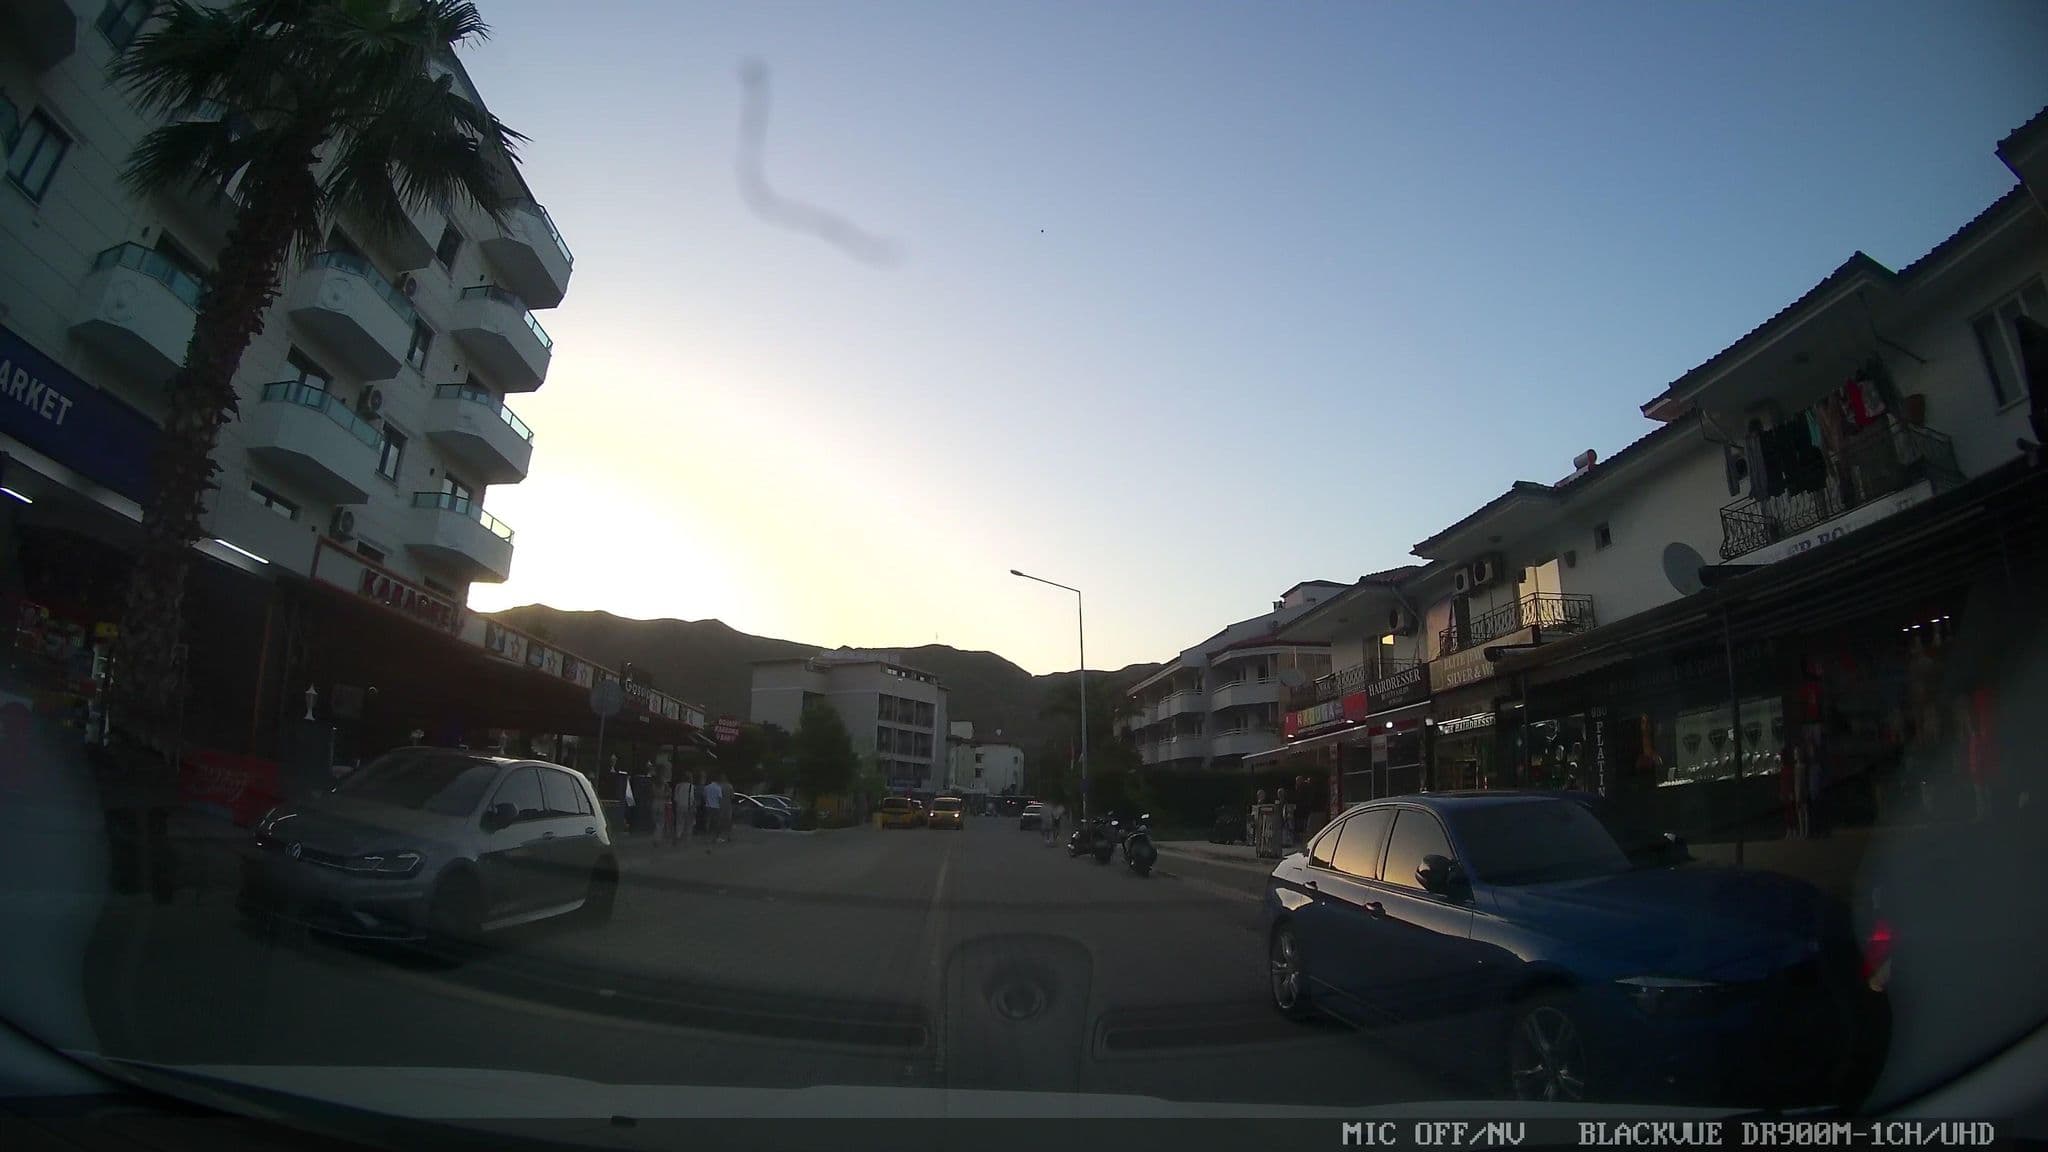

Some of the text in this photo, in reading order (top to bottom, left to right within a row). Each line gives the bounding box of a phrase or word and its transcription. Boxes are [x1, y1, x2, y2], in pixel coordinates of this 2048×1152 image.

[1368, 668, 1421, 697] HAIRDRESSER
[1446, 667, 1474, 687] SILVER
[1474, 665, 1482, 679] &
[1596, 720, 1607, 798] PLATIN
